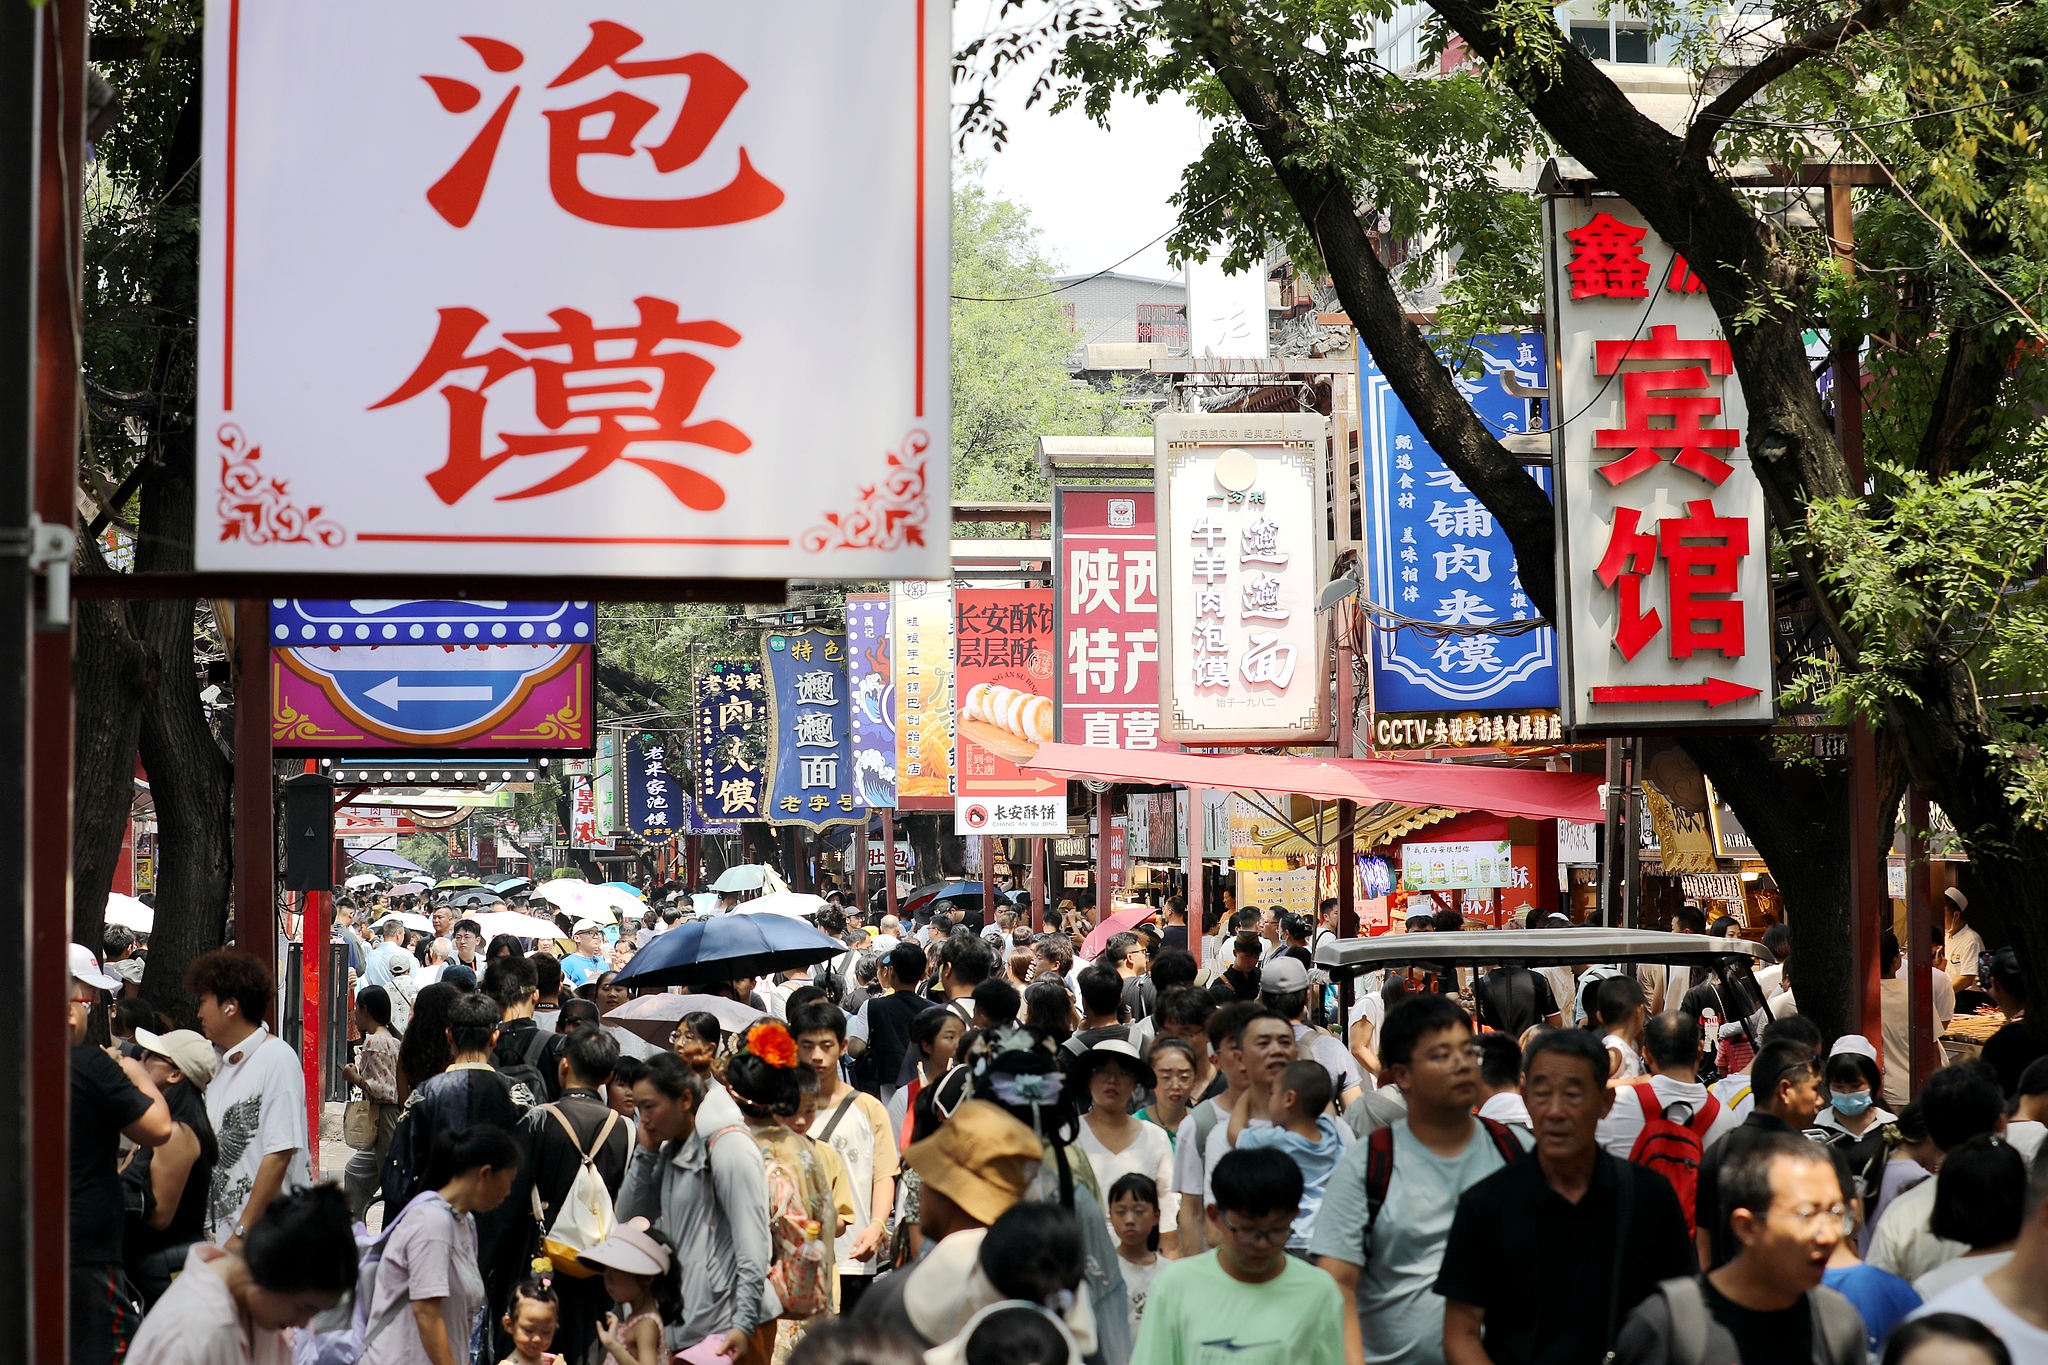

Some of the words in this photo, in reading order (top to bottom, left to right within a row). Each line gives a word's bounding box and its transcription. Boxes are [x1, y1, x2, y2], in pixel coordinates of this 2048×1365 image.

[365, 20, 785, 511] 泡馍
[1516, 342, 1538, 367] 真
[1207, 491, 1267, 504] 一分利
[1591, 324, 1751, 662] 宾馆
[1399, 526, 1421, 603] 美味相伴
[1069, 547, 1158, 615] 陕西
[1191, 517, 1230, 688] 牛羊肉泡馍
[791, 638, 845, 663] 特色
[1067, 627, 1159, 695] 特产
[702, 672, 764, 692] 老安家
[1015, 672, 1026, 680] SU
[1216, 698, 1276, 708] 始于一九八二
[1081, 711, 1160, 750] 直营
[780, 794, 853, 813] 老字号
[994, 804, 1056, 820] 长安酥饼
[643, 828, 673, 836] 老字号
[1073, 872, 1087, 885] 麻
